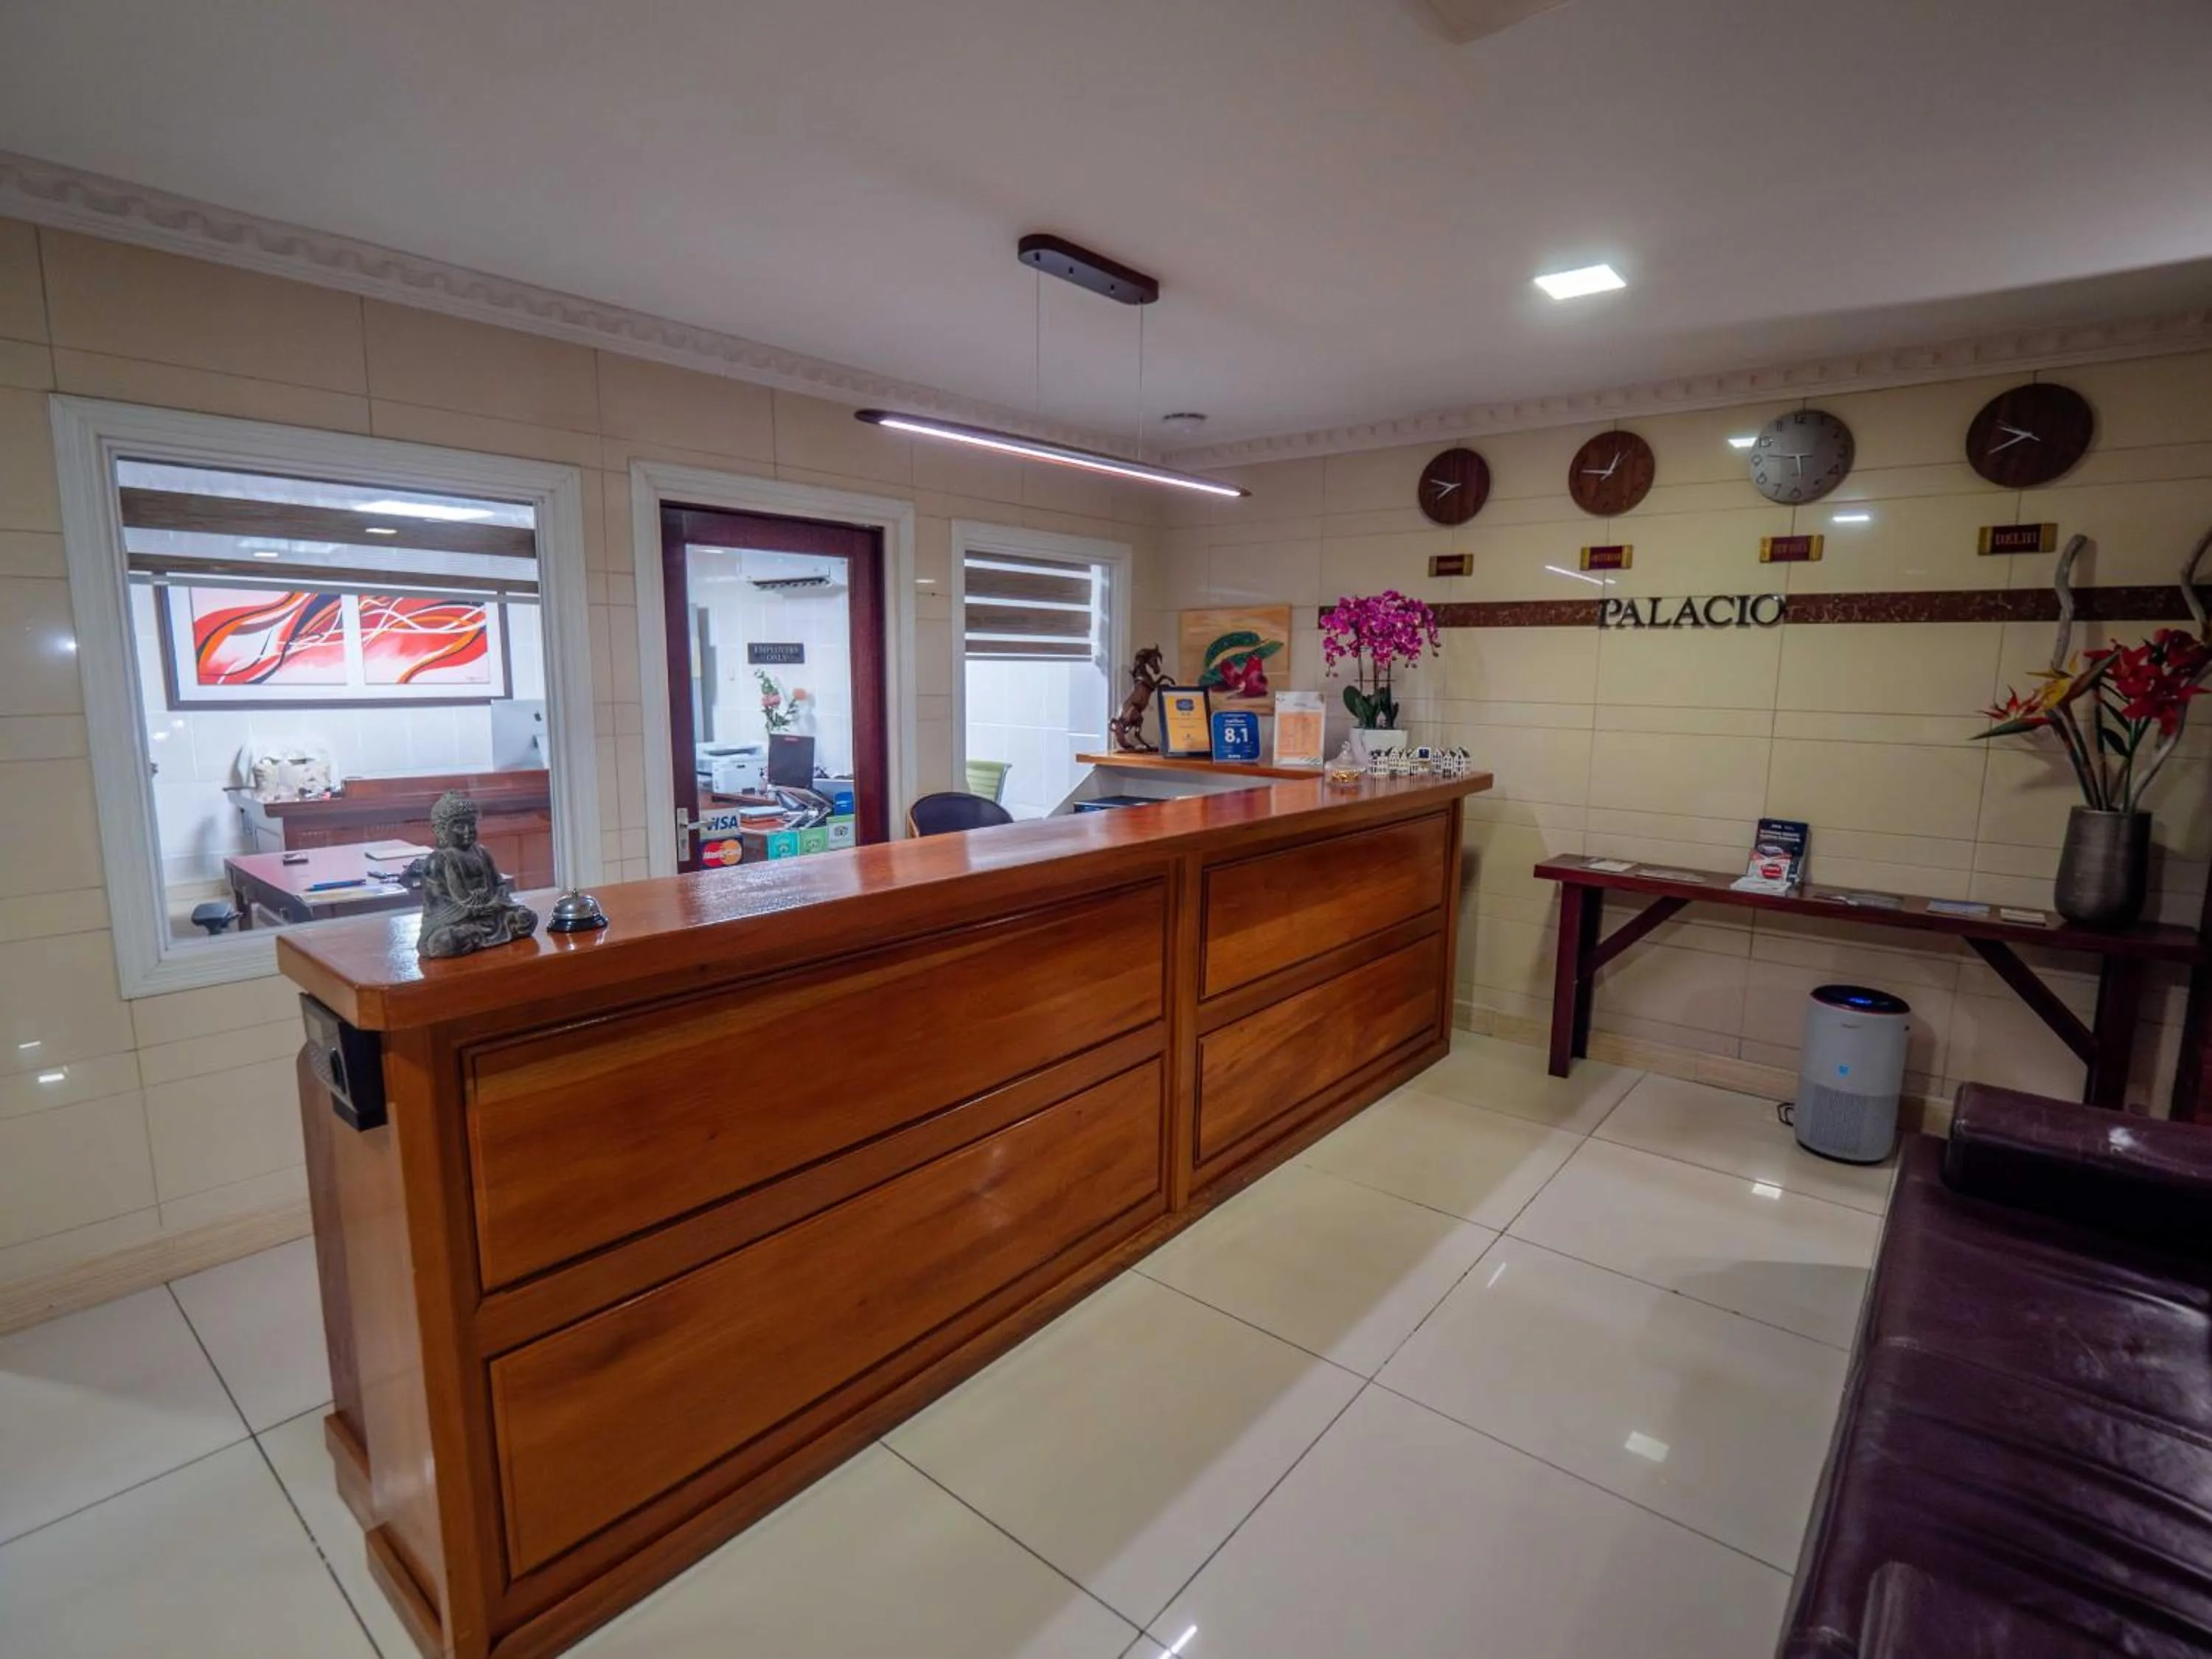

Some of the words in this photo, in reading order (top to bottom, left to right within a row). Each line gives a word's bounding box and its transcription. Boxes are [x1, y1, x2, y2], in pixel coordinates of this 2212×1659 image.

[1773, 483, 1782, 496] 7
[1994, 532, 2038, 546] DELHI
[1598, 593, 1787, 630] PALACIO
